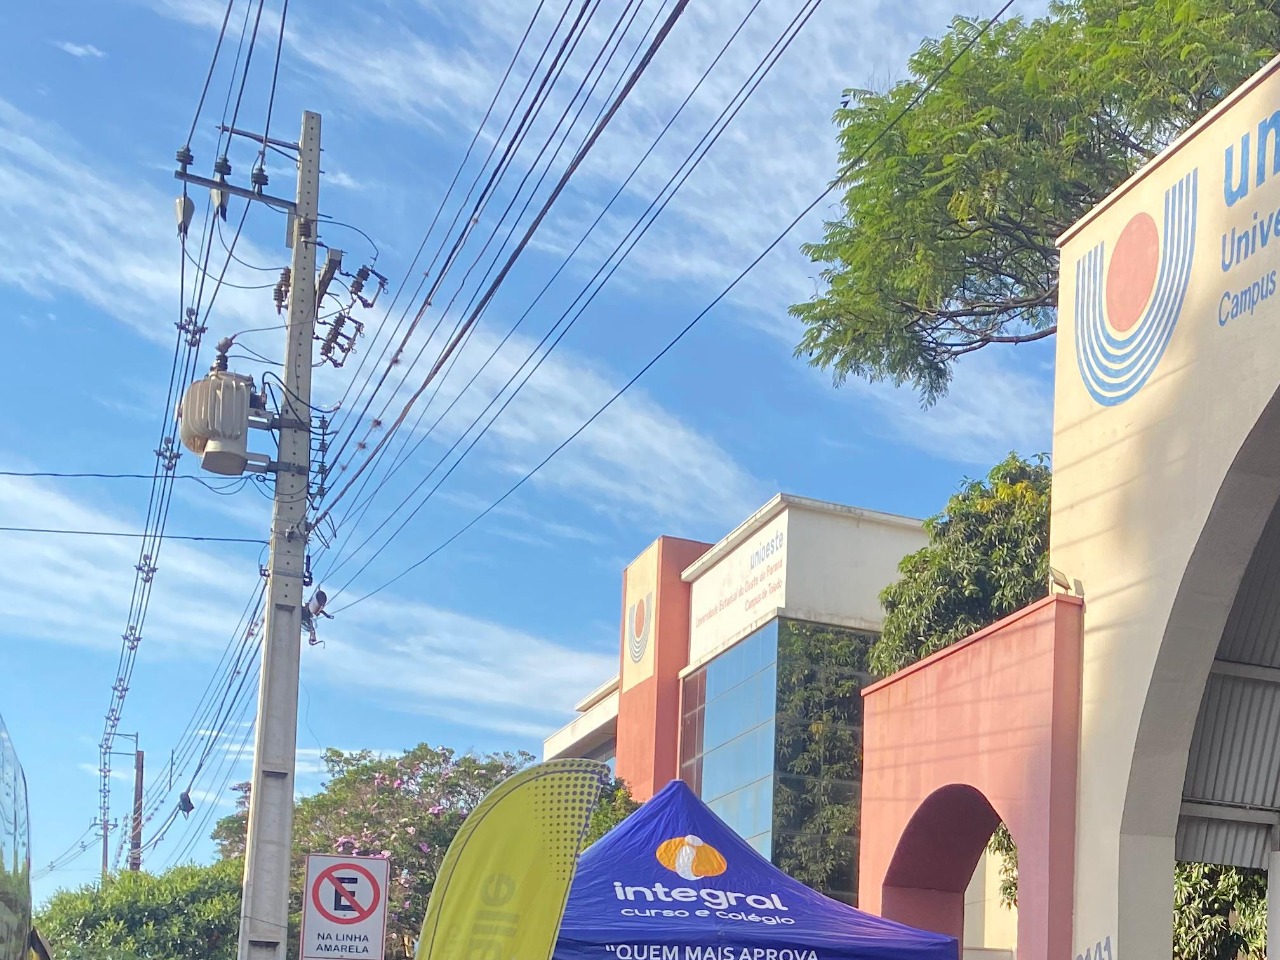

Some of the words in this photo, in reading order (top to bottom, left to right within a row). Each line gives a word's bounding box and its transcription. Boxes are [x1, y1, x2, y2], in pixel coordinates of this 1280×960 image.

[1218, 270, 1277, 327] Campus
[750, 529, 784, 570] unioeste
[613, 881, 789, 910] integral
[620, 907, 690, 918] curso
[694, 909, 710, 917] e
[715, 910, 796, 925] colégio
[316, 943, 369, 954] AMARELA
[317, 932, 332, 941] NA
[335, 933, 369, 942] LINHA
